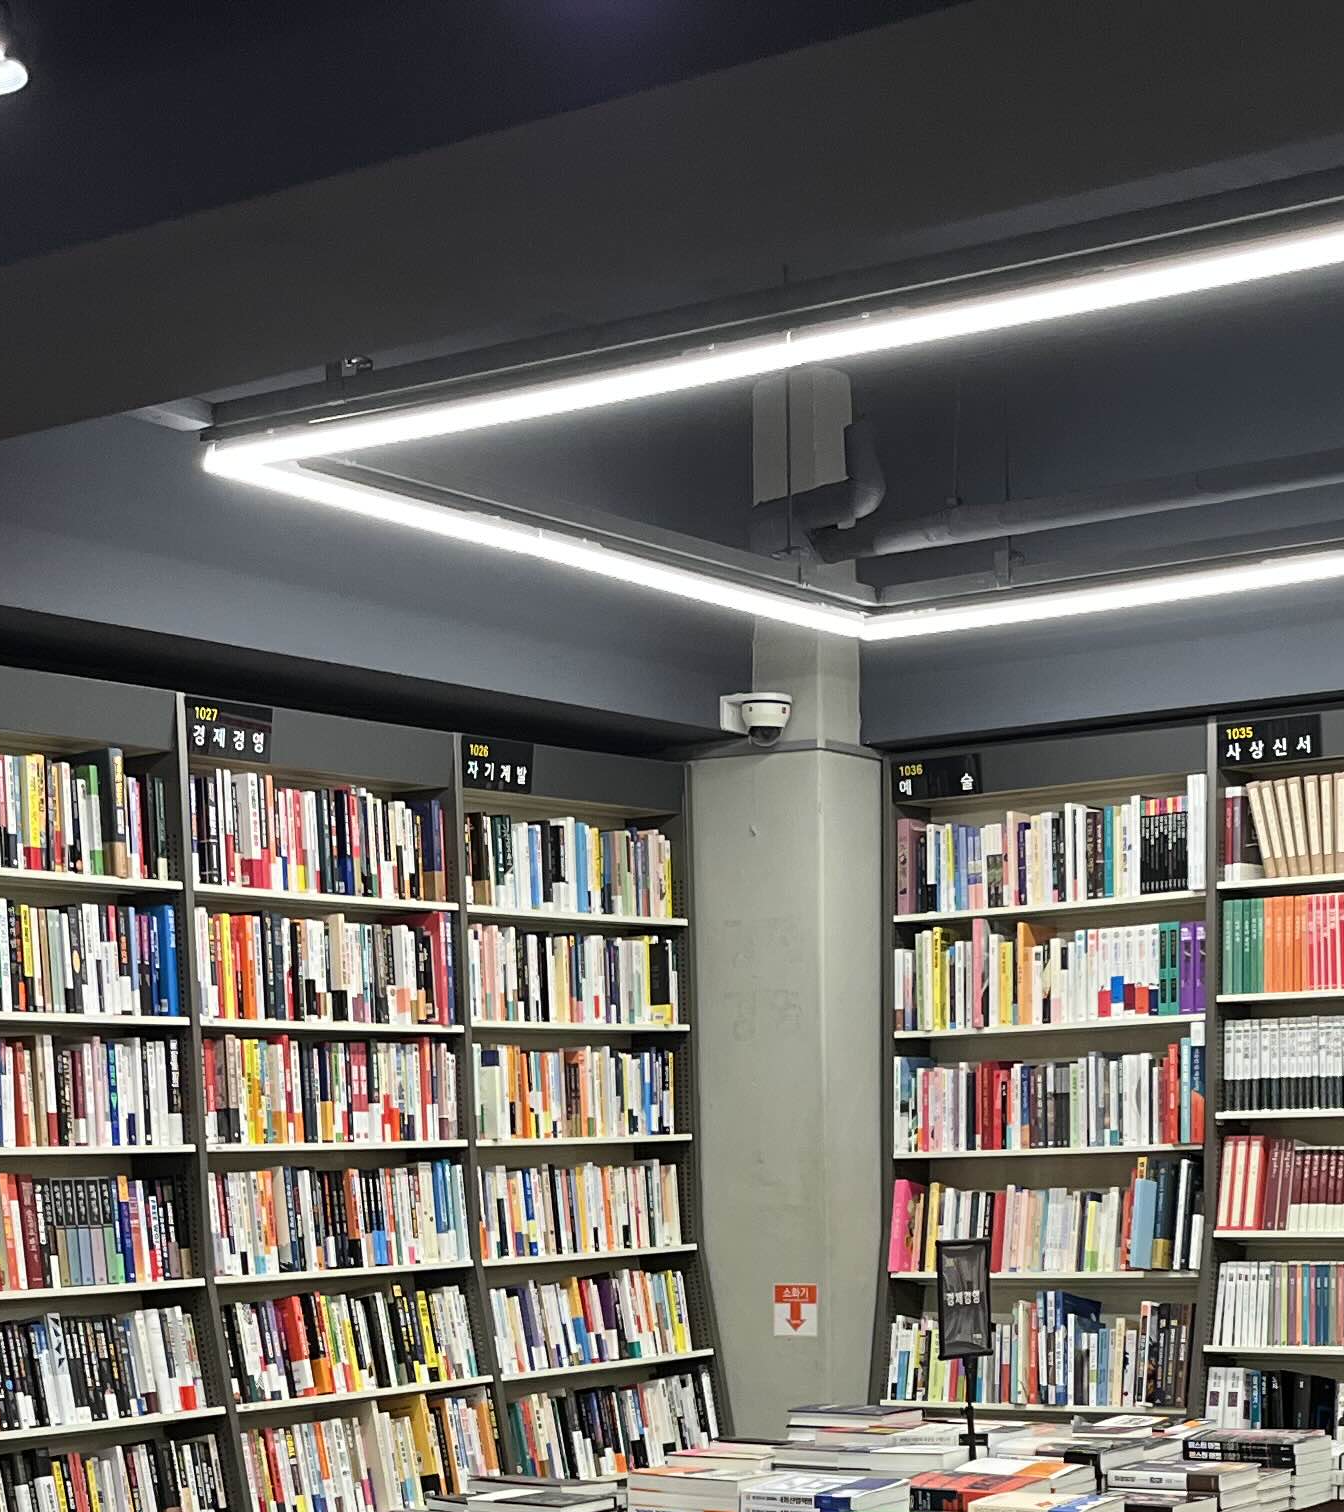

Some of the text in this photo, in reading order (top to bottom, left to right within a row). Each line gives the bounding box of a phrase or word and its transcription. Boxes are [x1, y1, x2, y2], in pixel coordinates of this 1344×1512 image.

[195, 706, 218, 722] 1027
[193, 725, 266, 755] 경제경영
[1226, 727, 1254, 741] 1035
[468, 743, 490, 759] 1026
[1226, 734, 1312, 761] 사상신서
[899, 765, 924, 778] 1036
[169, 1050, 179, 1071] Google
[782, 1287, 810, 1299] 소화기
